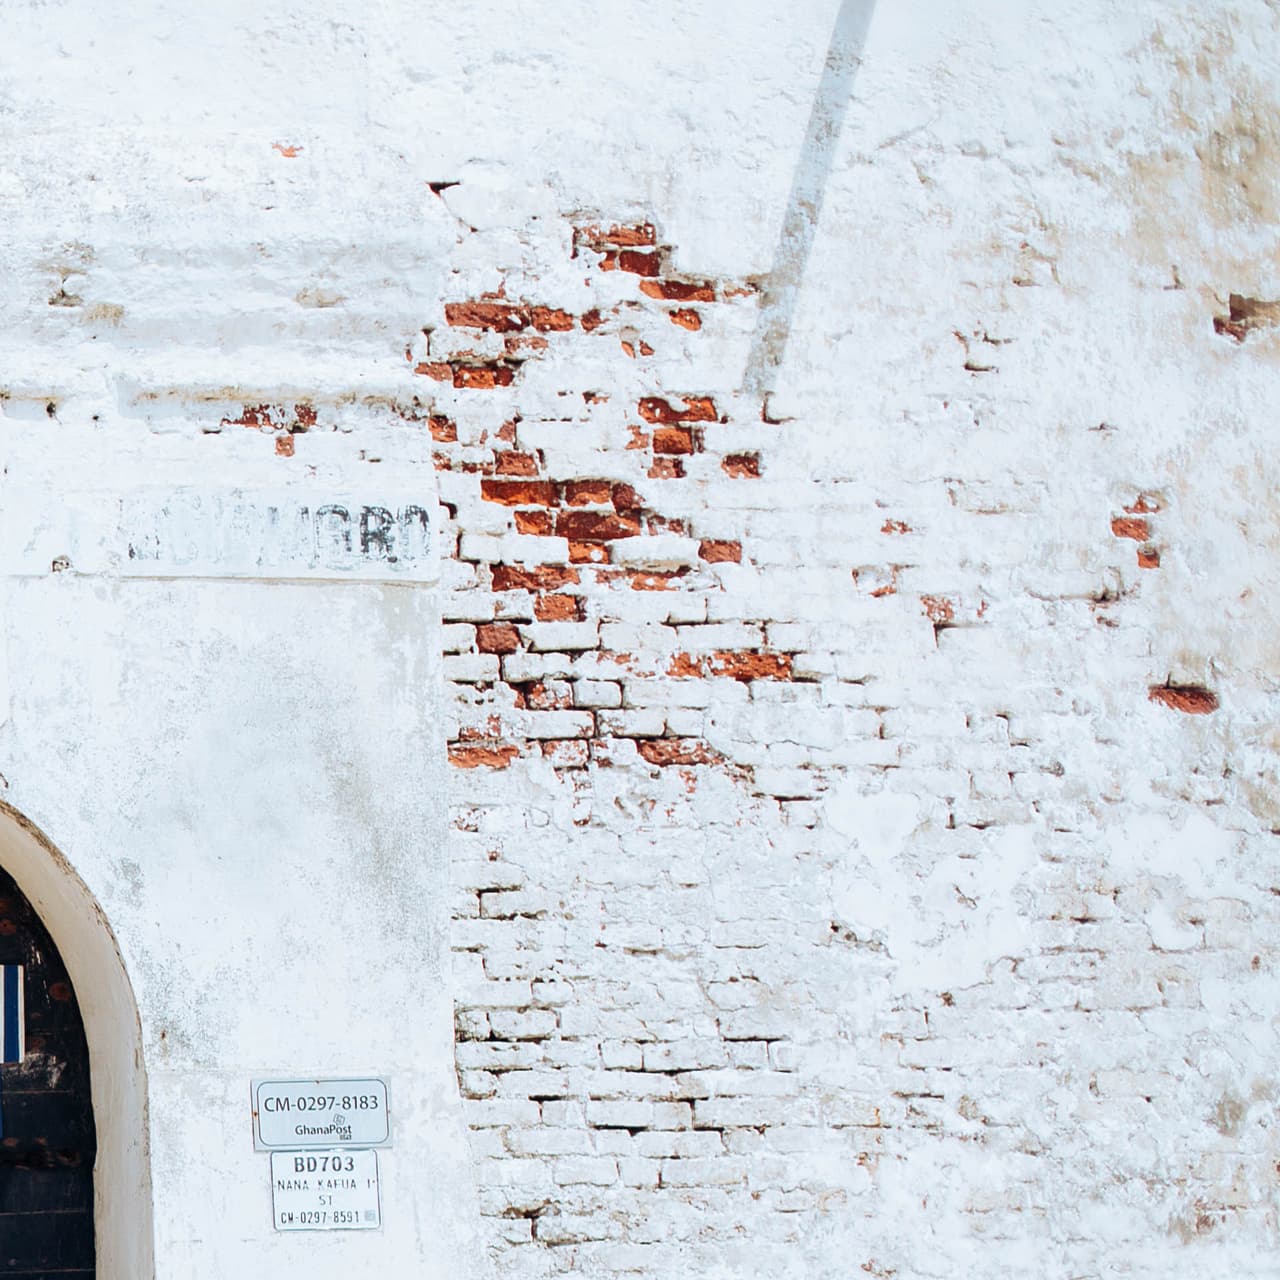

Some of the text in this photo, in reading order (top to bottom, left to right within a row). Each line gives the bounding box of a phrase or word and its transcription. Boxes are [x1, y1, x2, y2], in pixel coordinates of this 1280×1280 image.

[264, 1095, 379, 1112] CM-0297-8183
[295, 1124, 352, 1136] GhanaPost
[294, 1156, 355, 1173] BD703
[277, 1179, 309, 1190] NANA
